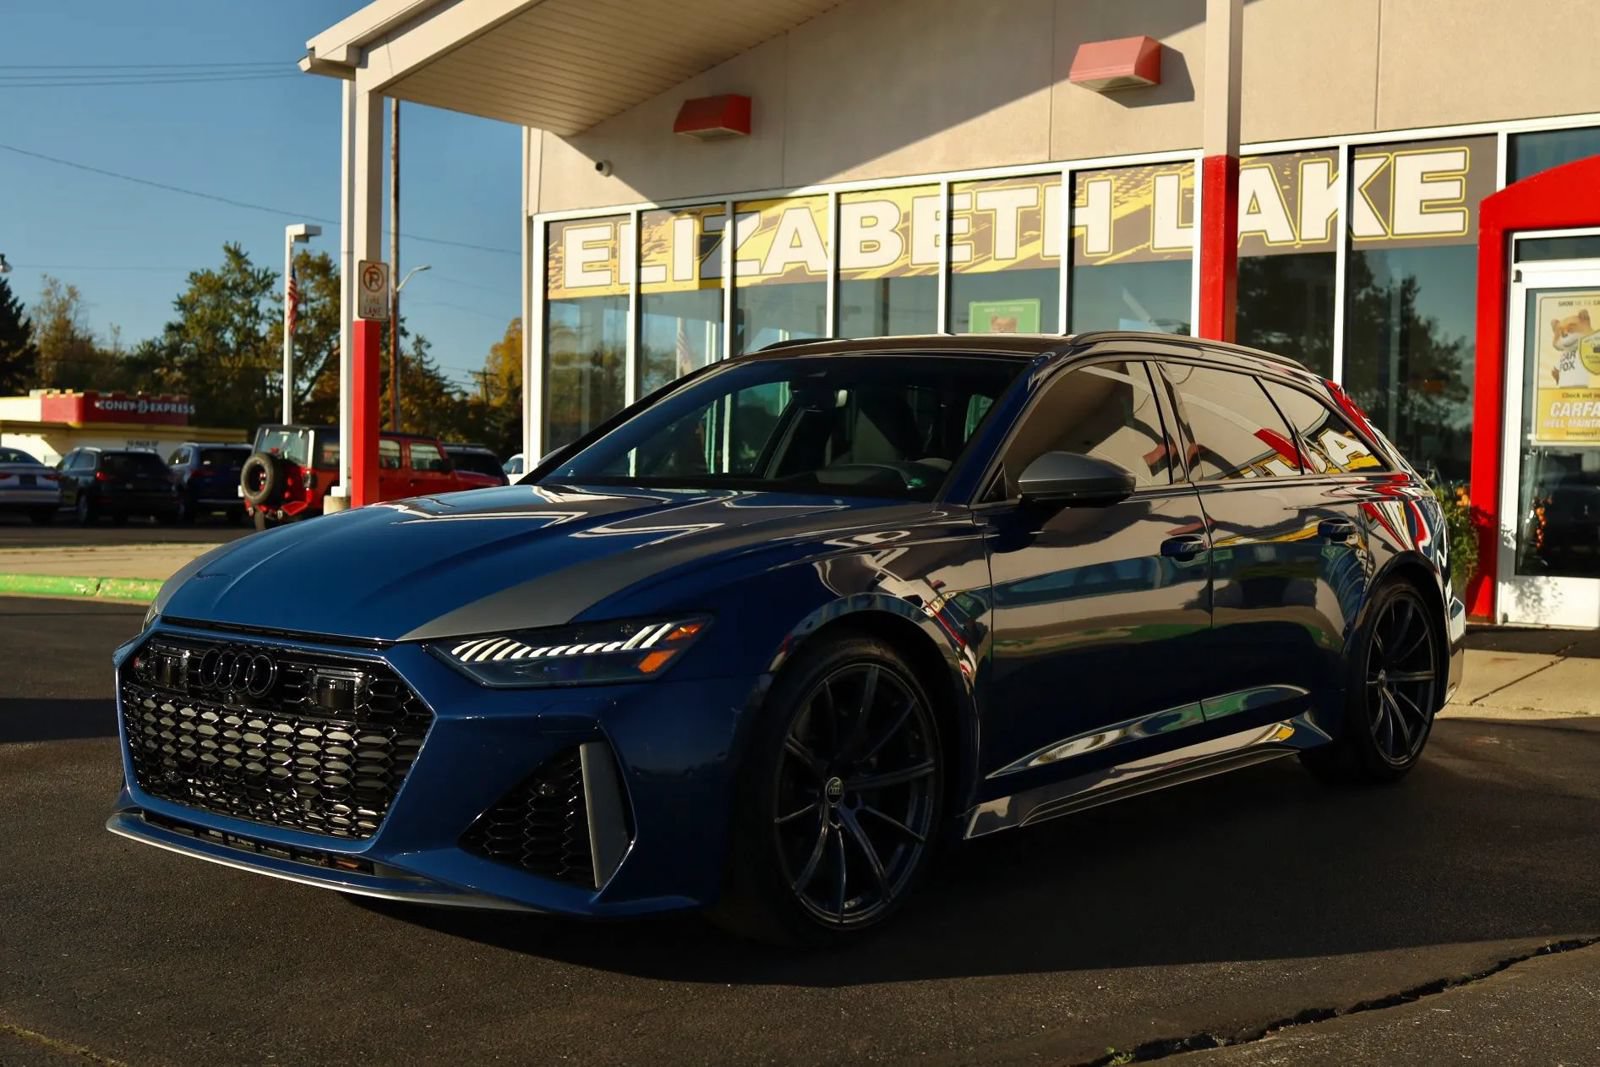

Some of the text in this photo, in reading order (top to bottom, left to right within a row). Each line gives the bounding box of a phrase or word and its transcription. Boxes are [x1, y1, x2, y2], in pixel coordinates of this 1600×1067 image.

[562, 146, 1470, 290] ELIZABETH LAKE
[99, 401, 196, 414] CONEY EXPRESS
